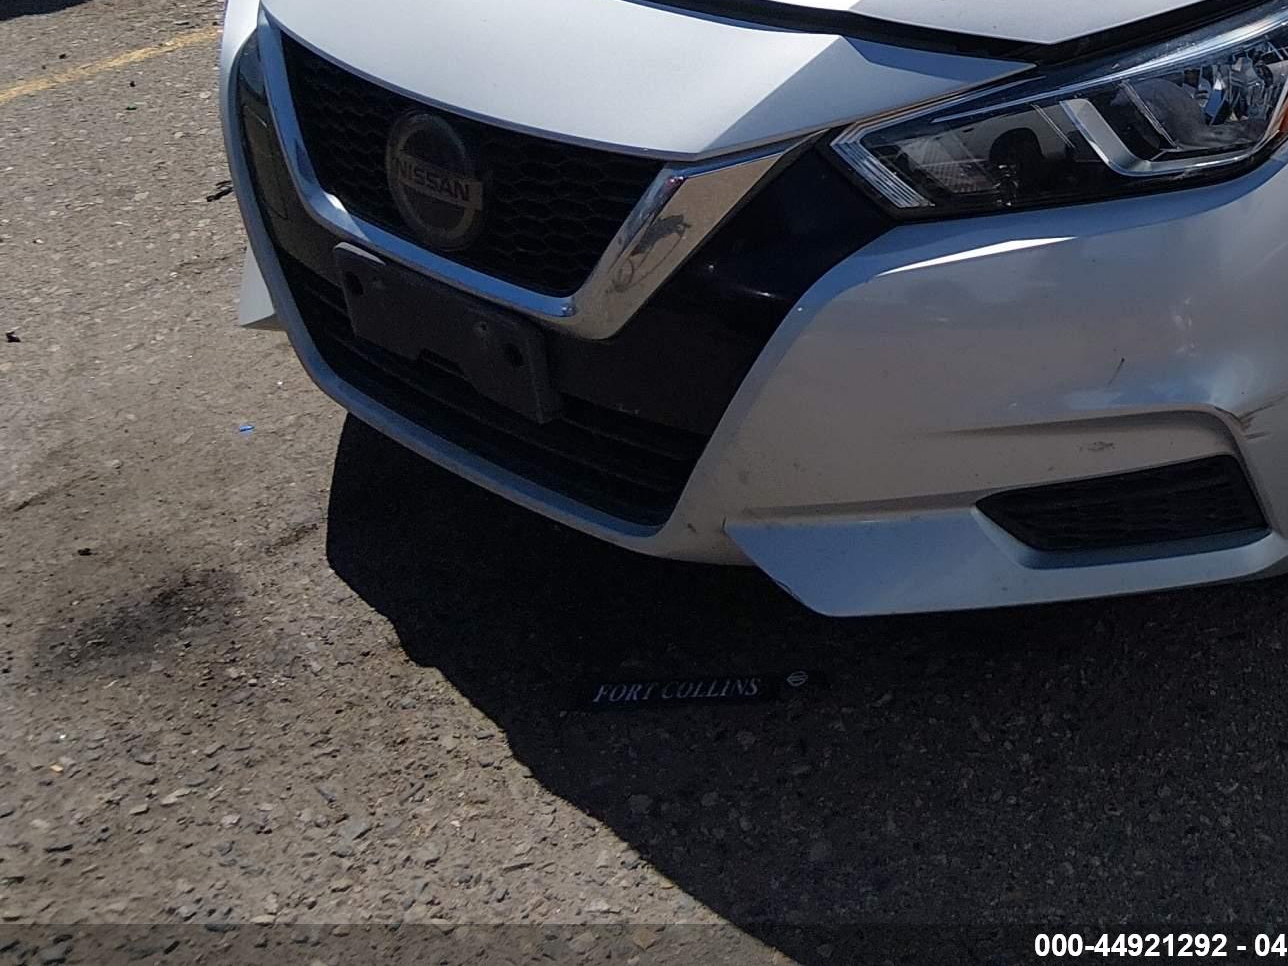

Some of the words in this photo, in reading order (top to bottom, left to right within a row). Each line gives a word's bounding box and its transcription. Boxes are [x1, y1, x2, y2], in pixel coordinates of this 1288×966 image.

[397, 157, 470, 202] NISSAN
[592, 683, 656, 703] FORT
[660, 678, 761, 699] COLLINS
